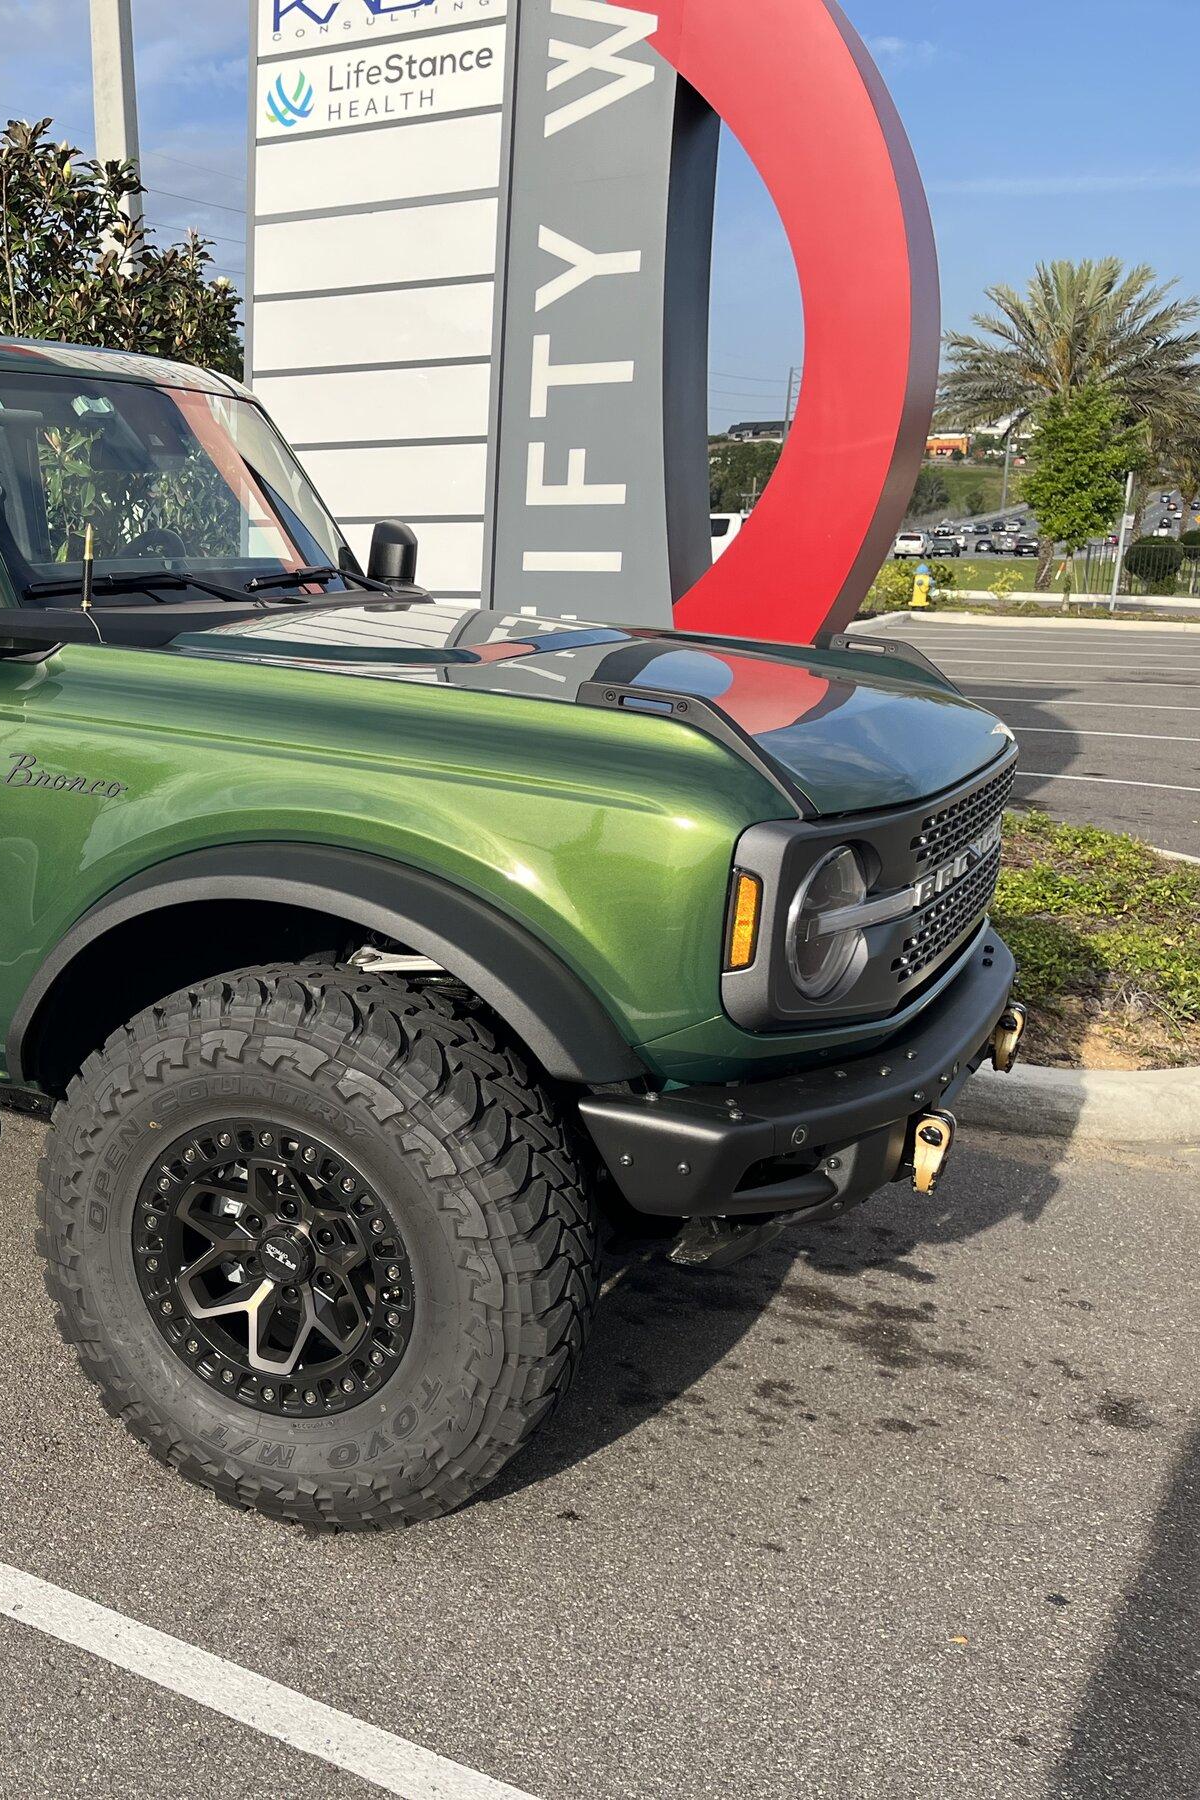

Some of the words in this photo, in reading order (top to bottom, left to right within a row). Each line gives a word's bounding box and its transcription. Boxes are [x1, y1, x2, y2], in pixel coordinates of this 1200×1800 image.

[328, 47, 494, 92] LifeStance
[328, 88, 435, 121] HEALTH
[520, 224, 642, 620] IFTY
[3, 752, 129, 798] Bronco
[87, 1115, 146, 1235] OPEN
[151, 1073, 375, 1139] COUNTRY
[326, 1373, 443, 1469] TOYO
[200, 1423, 297, 1469] M/T
